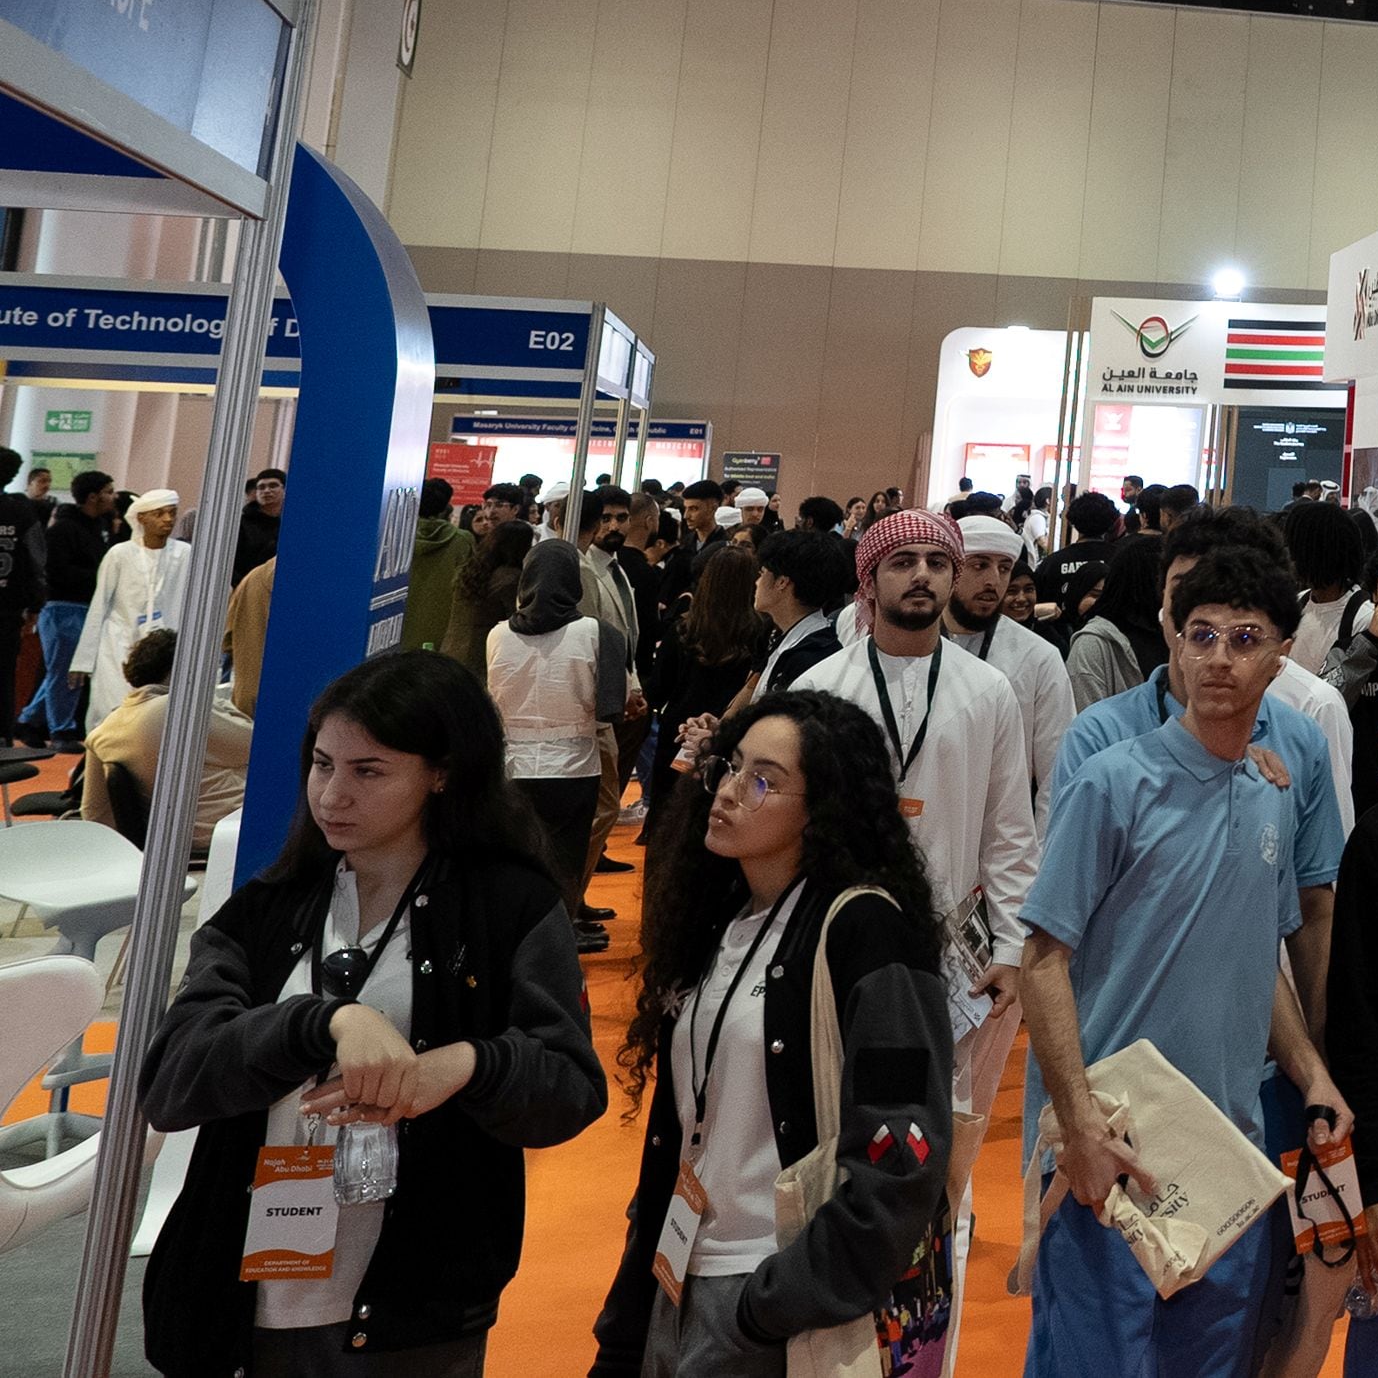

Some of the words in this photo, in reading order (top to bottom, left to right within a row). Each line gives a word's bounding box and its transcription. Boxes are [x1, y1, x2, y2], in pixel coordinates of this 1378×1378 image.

[47, 308, 76, 328] of
[84, 308, 225, 339] Technolog
[528, 329, 575, 351] E02
[1102, 366, 1146, 381] العين
[1149, 367, 1198, 383] جامعة
[1101, 383, 1114, 393] AL
[1116, 384, 1134, 393] AIN
[1136, 385, 1198, 394] UNIVERSITY
[504, 422, 541, 432] University
[750, 984, 767, 999] EP
[274, 1165, 289, 1174] Abu
[290, 1164, 313, 1173] Dhabi
[1301, 1183, 1346, 1205] STUDT
[265, 1206, 323, 1217] STUDENT
[263, 1259, 299, 1267] DEPARTMENT
